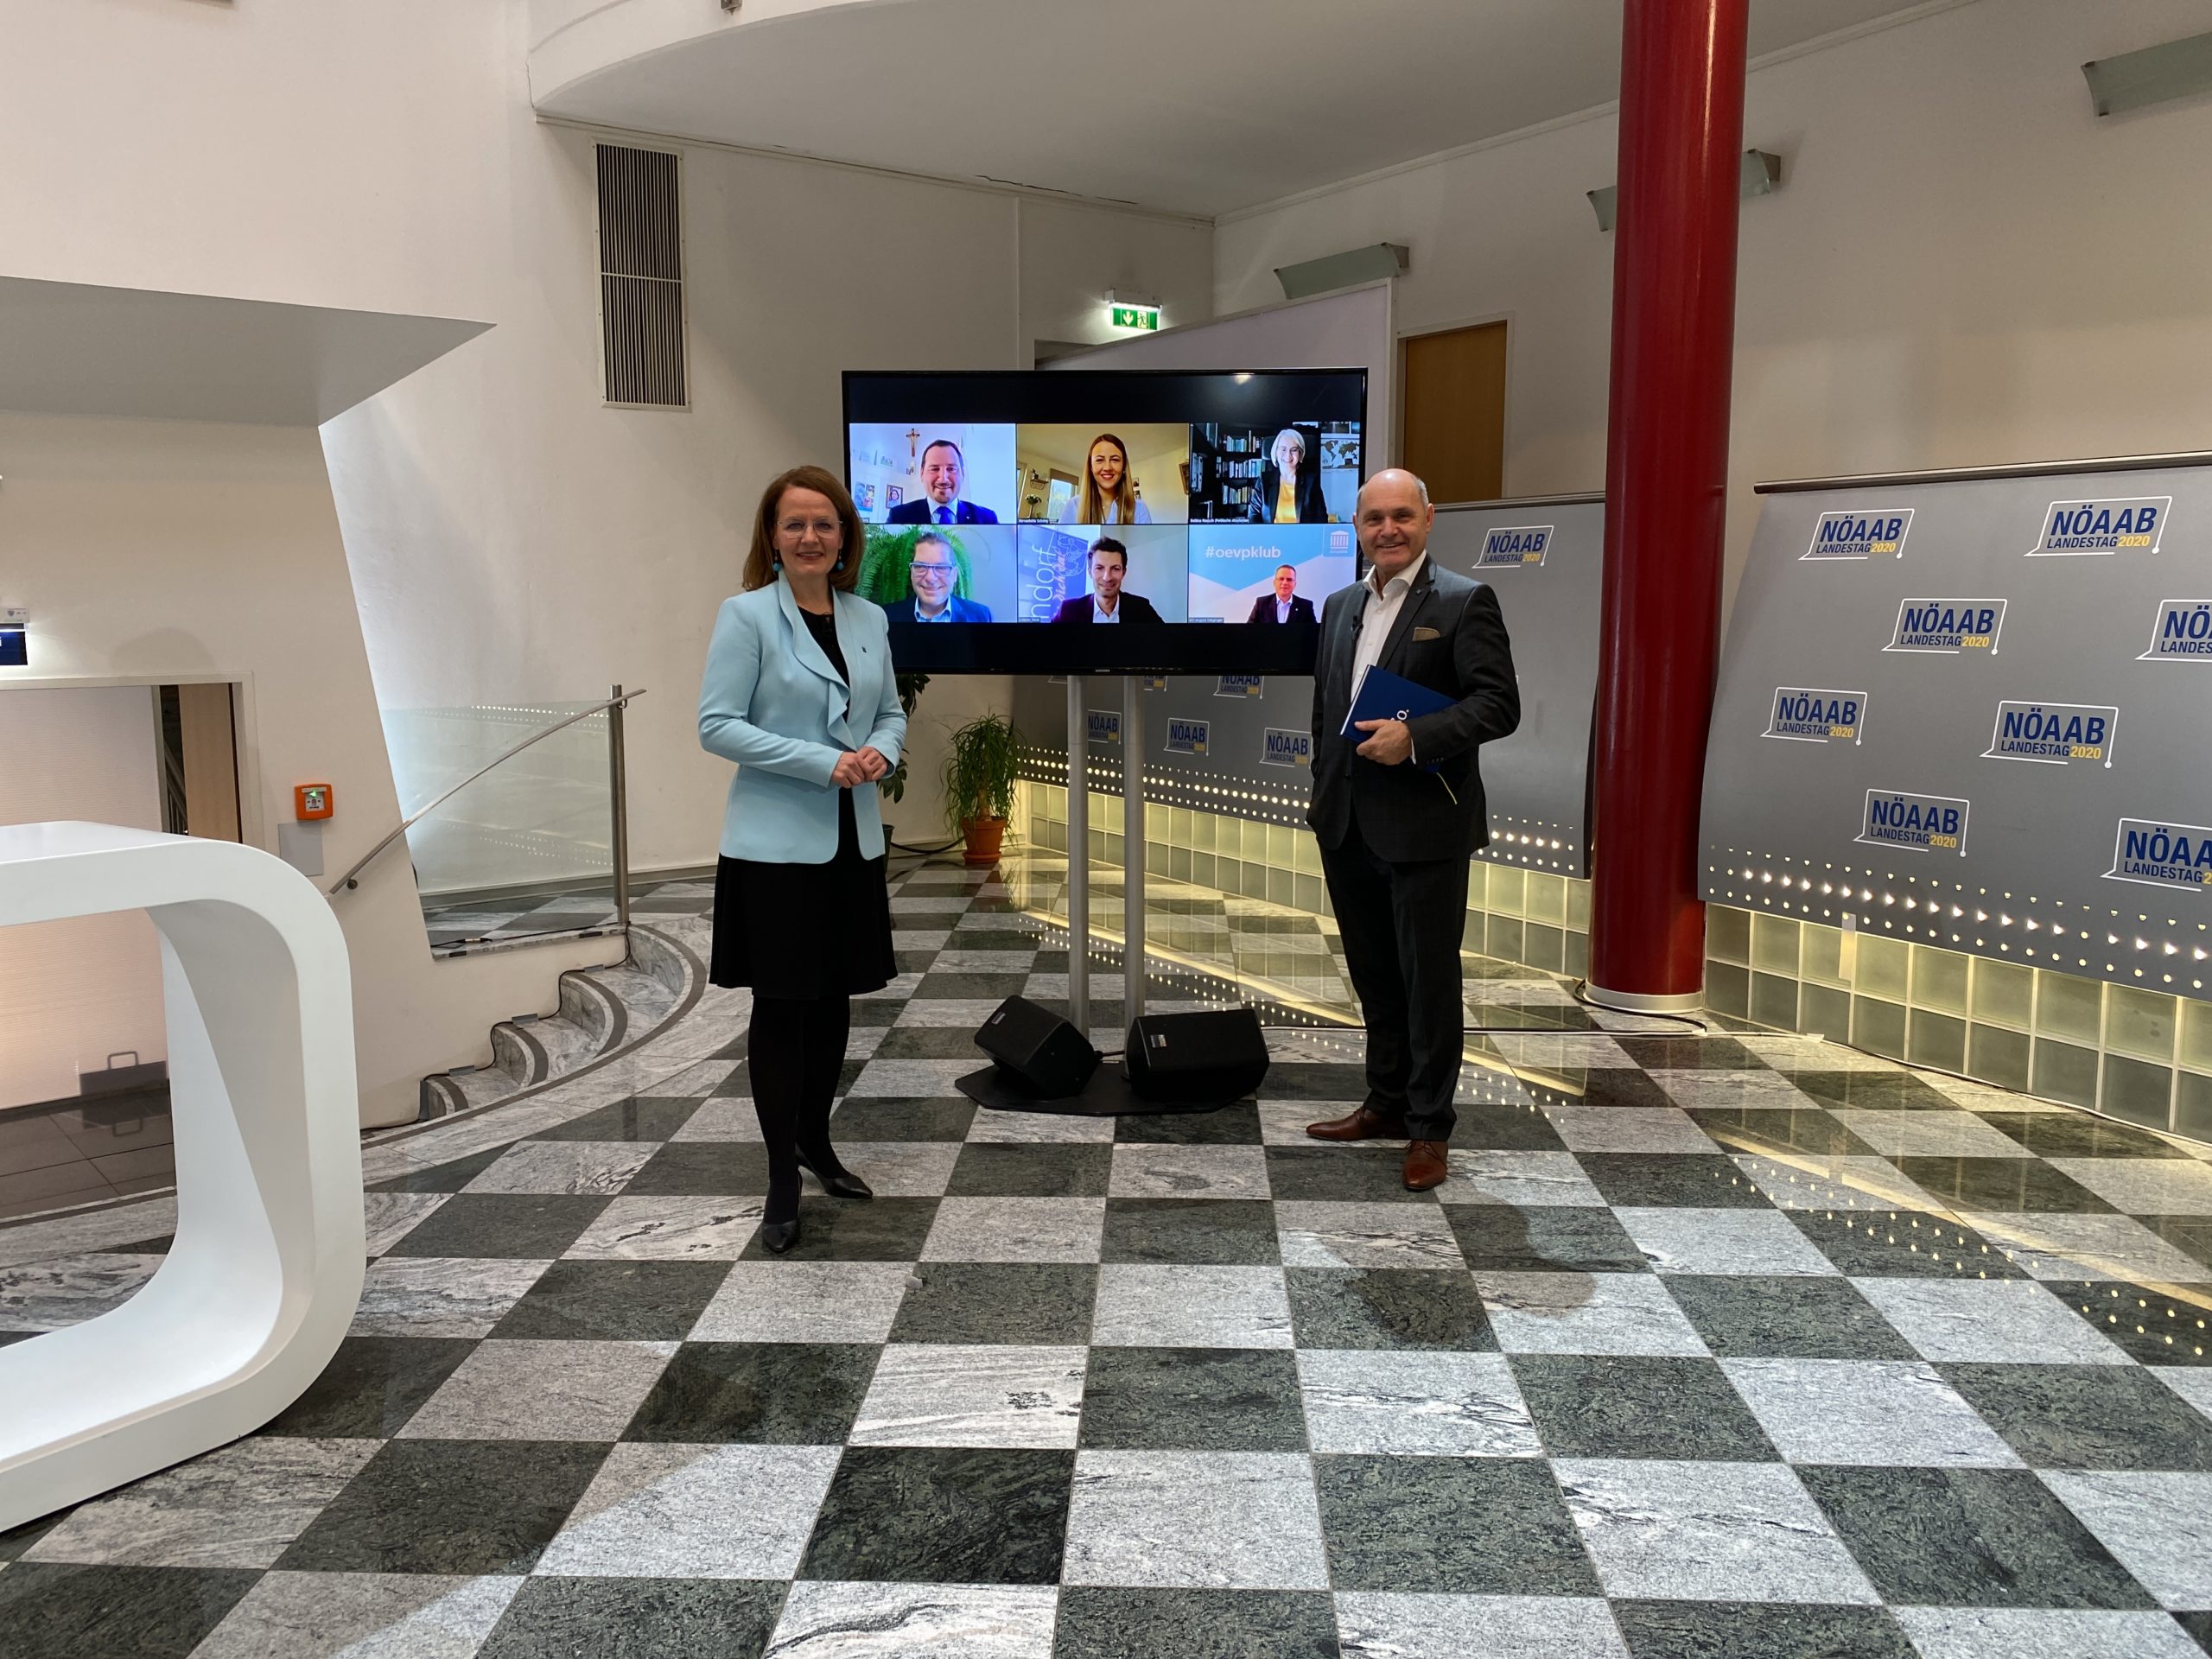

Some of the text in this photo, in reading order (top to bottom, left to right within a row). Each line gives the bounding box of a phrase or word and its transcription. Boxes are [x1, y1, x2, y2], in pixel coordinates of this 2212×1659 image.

[1819, 515, 1903, 543] NÖAAB
[2050, 505, 2158, 536] NÖAAB
[1205, 545, 1281, 561] #oevpklub
[1487, 531, 1545, 554] NÖAAB
[1026, 544, 1056, 619] ndorf
[1903, 603, 1995, 634] NÖAAB
[2164, 605, 2212, 639] NÖ
[1778, 693, 1858, 725] NÖAAB
[1171, 721, 1205, 743] NÖAAB
[2003, 708, 2106, 745] NÖAAB
[1268, 733, 1308, 755] NÖAAB
[1872, 797, 1960, 835] NÖAAB
